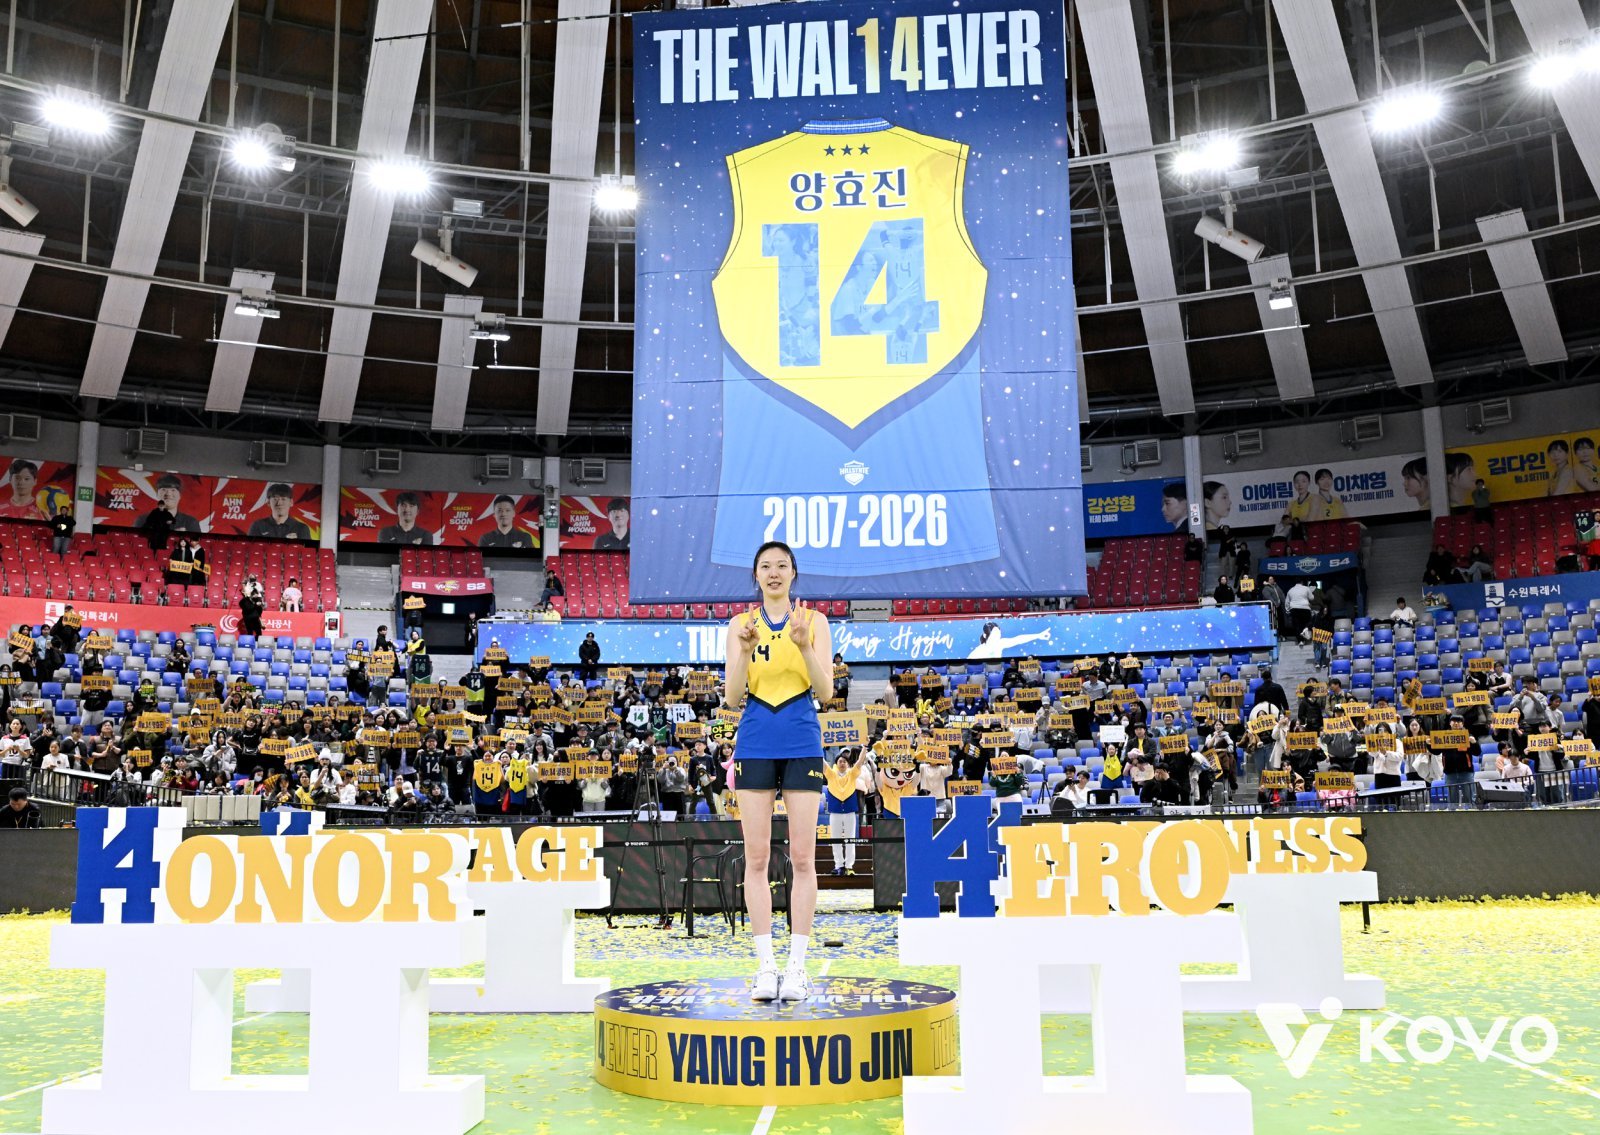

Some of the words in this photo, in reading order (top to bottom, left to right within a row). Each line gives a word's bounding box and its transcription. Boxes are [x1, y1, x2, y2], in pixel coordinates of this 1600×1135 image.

[653, 27, 739, 103] THE
[748, 10, 1043, 100] WAL14EVER
[790, 168, 906, 211] 양효진
[761, 217, 940, 367] 14
[1488, 452, 1546, 475] 김다인
[1333, 471, 1387, 492] 이채영
[111, 488, 140, 496] GONG
[1242, 481, 1293, 501] 이예림
[1353, 492, 1375, 502] OUTSIDE
[1376, 490, 1394, 499] HITTER
[111, 495, 133, 503] JAE
[223, 498, 243, 507] AHN
[108, 502, 135, 510] HAK
[1087, 495, 1136, 514] 강성형
[454, 511, 469, 519] JIN
[763, 493, 948, 548] 2007-2026
[1267, 562, 1288, 571] S3
[1329, 557, 1350, 568] S4
[411, 581, 426, 590] S1
[466, 582, 486, 591] S2
[1508, 584, 1561, 598] 수원특례시
[72, 610, 118, 623] 원특례시
[470, 679, 481, 689] 14
[1415, 703, 1430, 711] No.14
[579, 711, 590, 719] No.14
[634, 712, 645, 722] 14
[676, 712, 686, 722] 14
[827, 719, 854, 729] No.14
[822, 729, 860, 744] 양효진
[1434, 736, 1450, 744] No.14
[1451, 735, 1466, 744] 양효진
[1162, 741, 1174, 749] No.14
[1537, 738, 1553, 747] 양효진
[426, 762, 440, 774] 14
[541, 768, 556, 776] No.14
[557, 767, 572, 777] 양효진
[579, 766, 594, 774] No.14
[481, 772, 494, 785] 14
[511, 770, 524, 783] 14
[1263, 775, 1276, 784] No.14
[1318, 777, 1334, 786] No.14
[1335, 777, 1351, 787] 양효진
[951, 785, 964, 794] No.14
[667, 1031, 766, 1087] YANG
[775, 1033, 851, 1087] HYO
[860, 1027, 914, 1082] JIN
